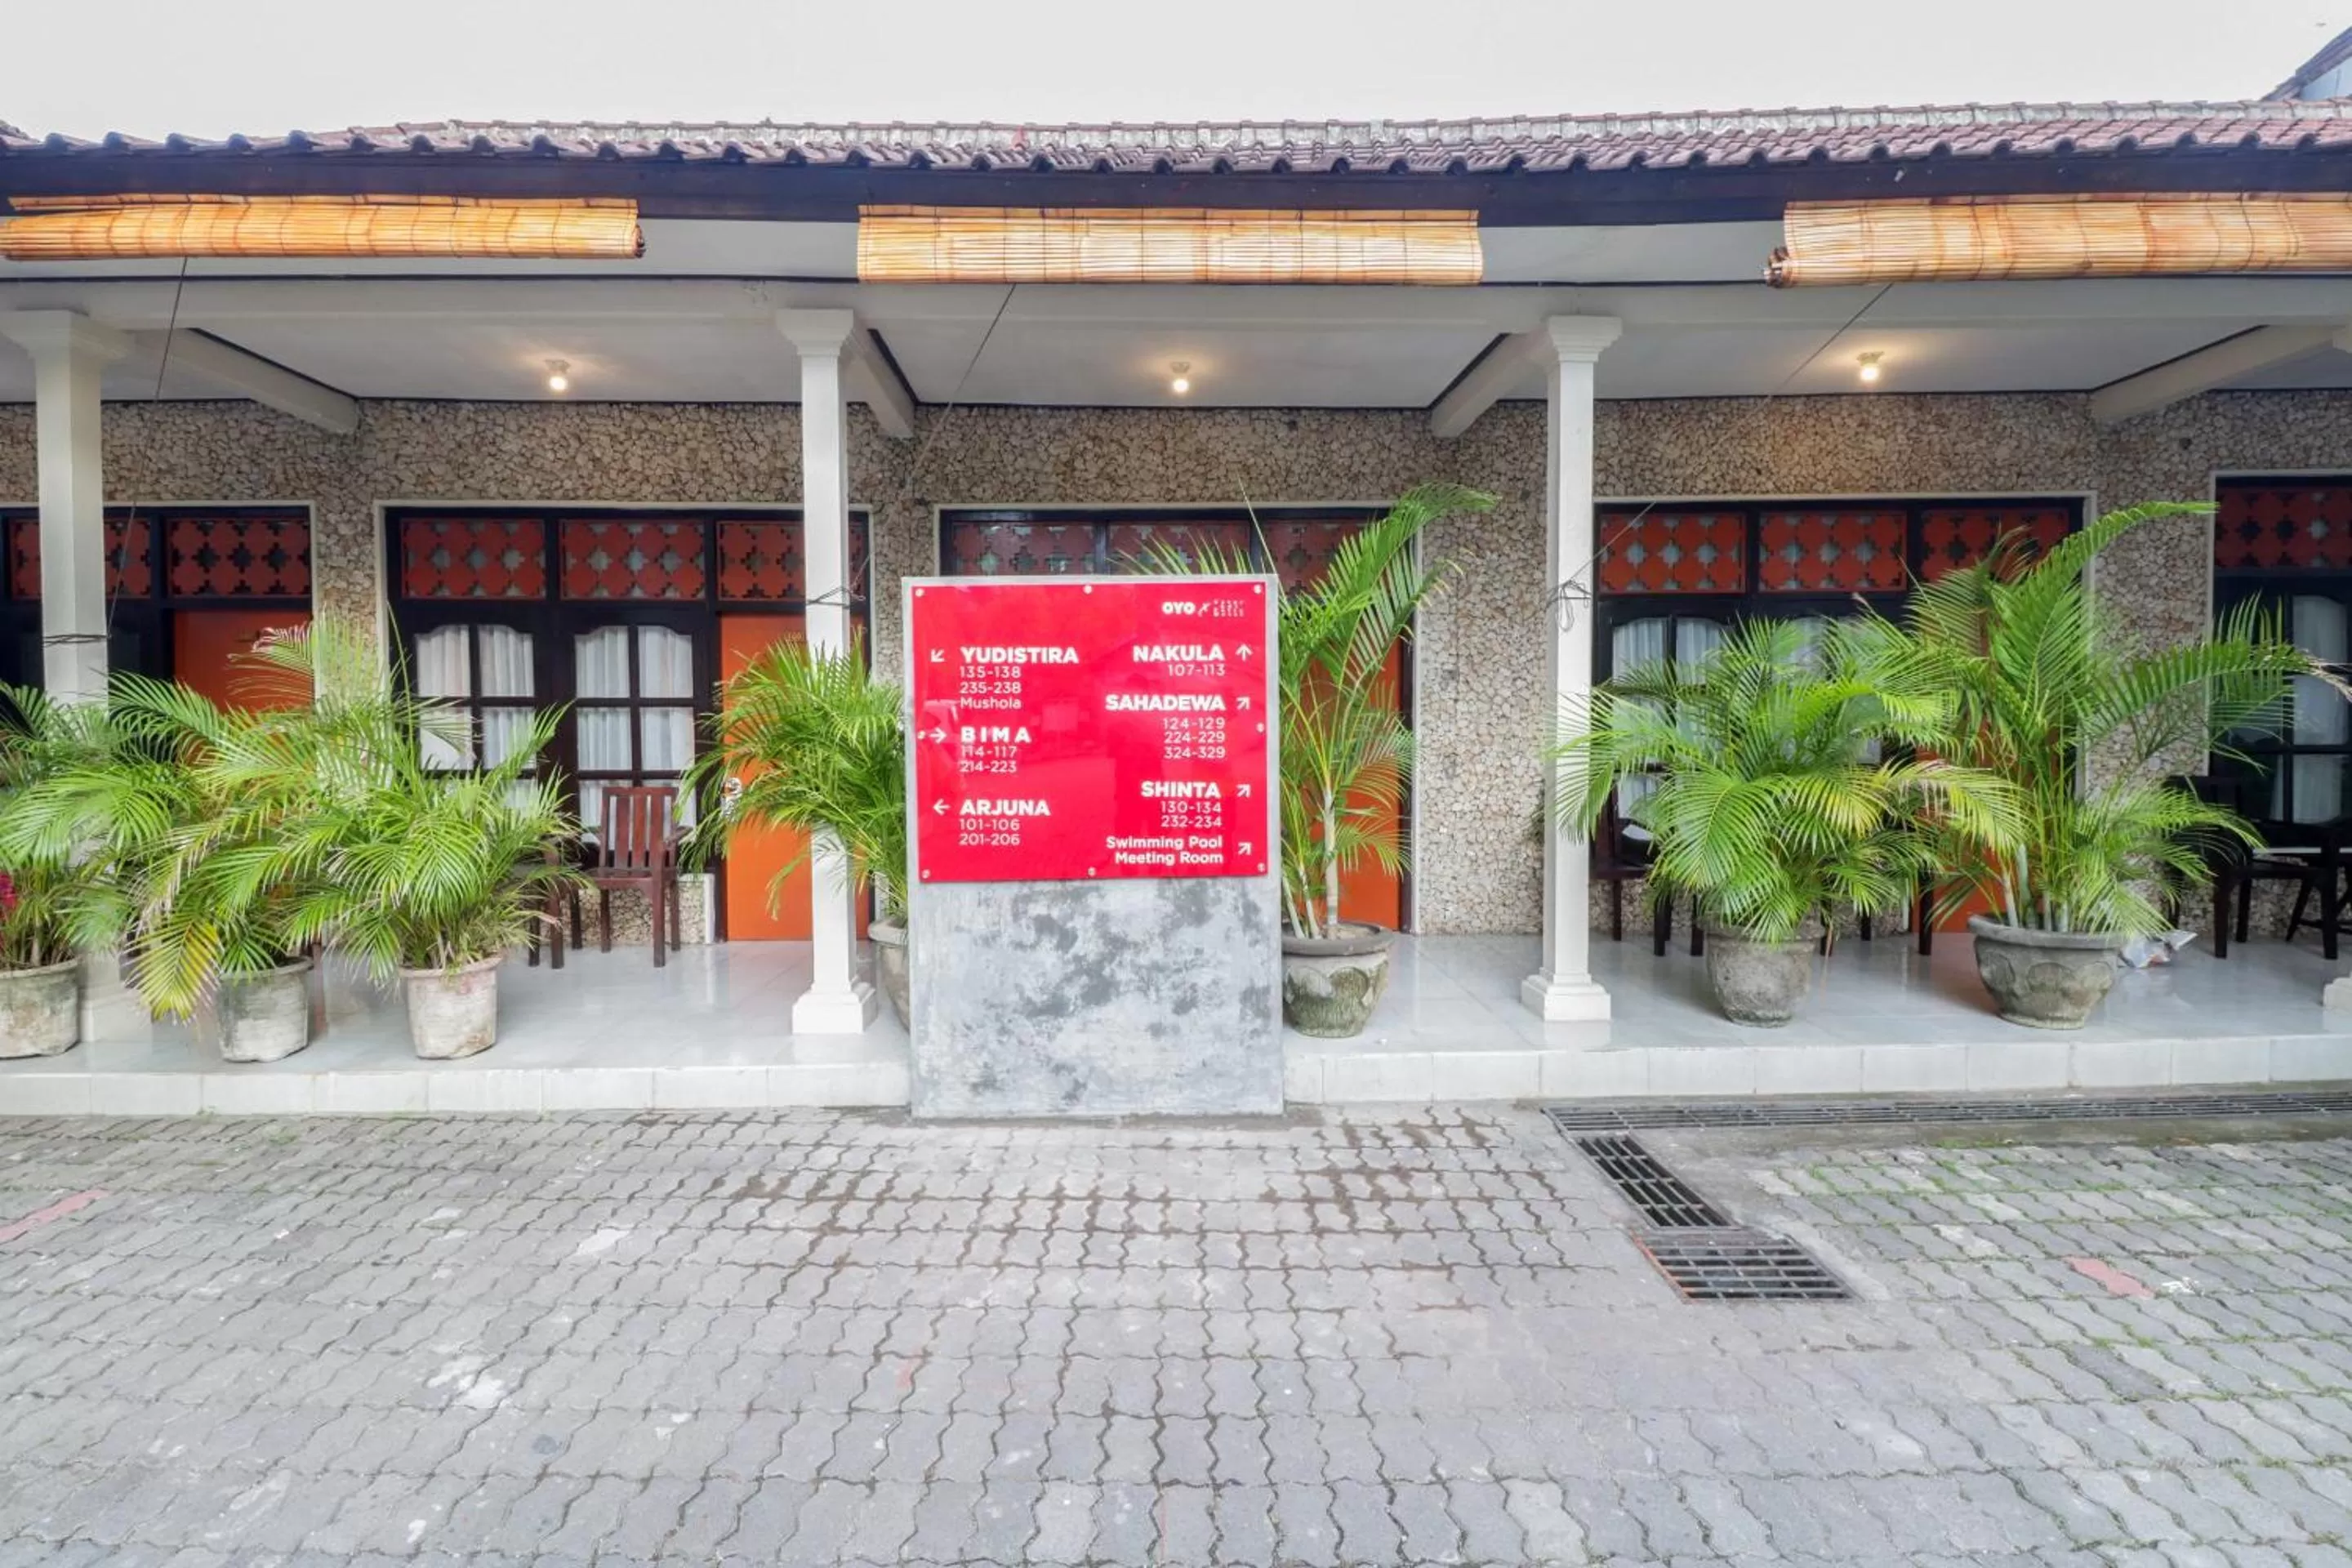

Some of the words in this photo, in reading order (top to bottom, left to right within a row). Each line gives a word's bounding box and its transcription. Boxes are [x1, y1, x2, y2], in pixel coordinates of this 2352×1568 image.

[1162, 601, 1196, 615] OYO
[960, 647, 1079, 663] YUDISTIRA
[1133, 644, 1225, 662] NAKULA
[960, 666, 1021, 679] 135-138
[1168, 664, 1225, 676] 107-113
[960, 681, 1022, 694] 235-238
[960, 697, 1022, 710] Mushola
[1105, 694, 1226, 711] SAHADEWA
[1163, 717, 1225, 729] 124-129
[960, 726, 1032, 743] BIMA
[1164, 731, 1225, 743] 224-229
[961, 746, 1018, 758] 114-117
[1164, 746, 1226, 759] 324-329
[960, 760, 1018, 773] 214-223
[1141, 781, 1222, 798] SHINTA
[960, 799, 1051, 816] ARJUNA
[1160, 800, 1222, 813] 130-134
[959, 818, 1020, 831] 101-106
[1160, 815, 1223, 828] 232-234
[959, 833, 1021, 846] 201-206
[1106, 835, 1184, 850] Swimming
[1188, 835, 1223, 849] Pool
[1115, 851, 1176, 866] Meeting
[1179, 851, 1223, 864] Room
